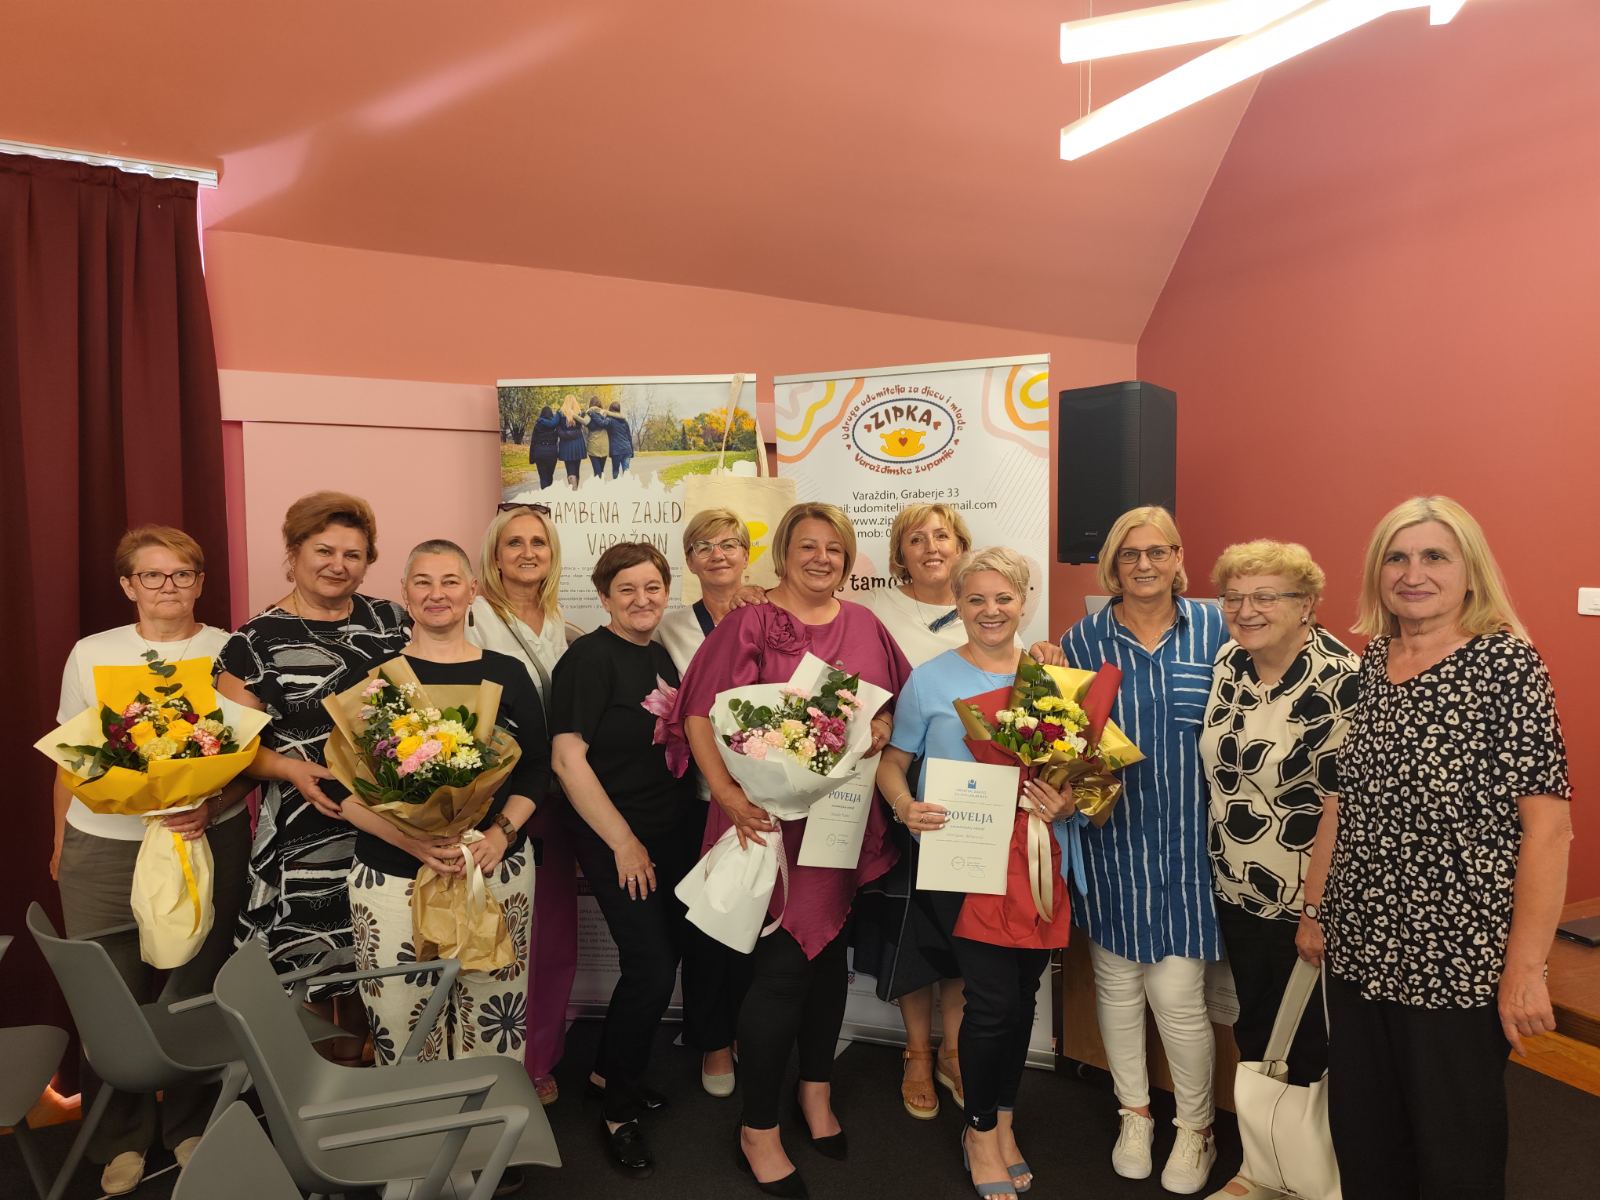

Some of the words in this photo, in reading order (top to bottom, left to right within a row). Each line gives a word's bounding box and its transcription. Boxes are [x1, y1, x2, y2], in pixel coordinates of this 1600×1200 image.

[841, 405, 860, 440] Udruga
[860, 384, 906, 406] udomitelja
[921, 385, 945, 401] djecu
[950, 402, 967, 431] mlade
[869, 404, 932, 430] ZIPKA
[854, 452, 912, 476] Varaždinske
[915, 447, 955, 474] županije
[852, 490, 899, 501] Varaždin,
[900, 488, 945, 500] Graberje
[947, 487, 960, 498] 33
[631, 501, 686, 524] ZAJED
[857, 528, 884, 538] mob:
[828, 789, 861, 803] POVELJA
[944, 810, 994, 824] POVELJA
